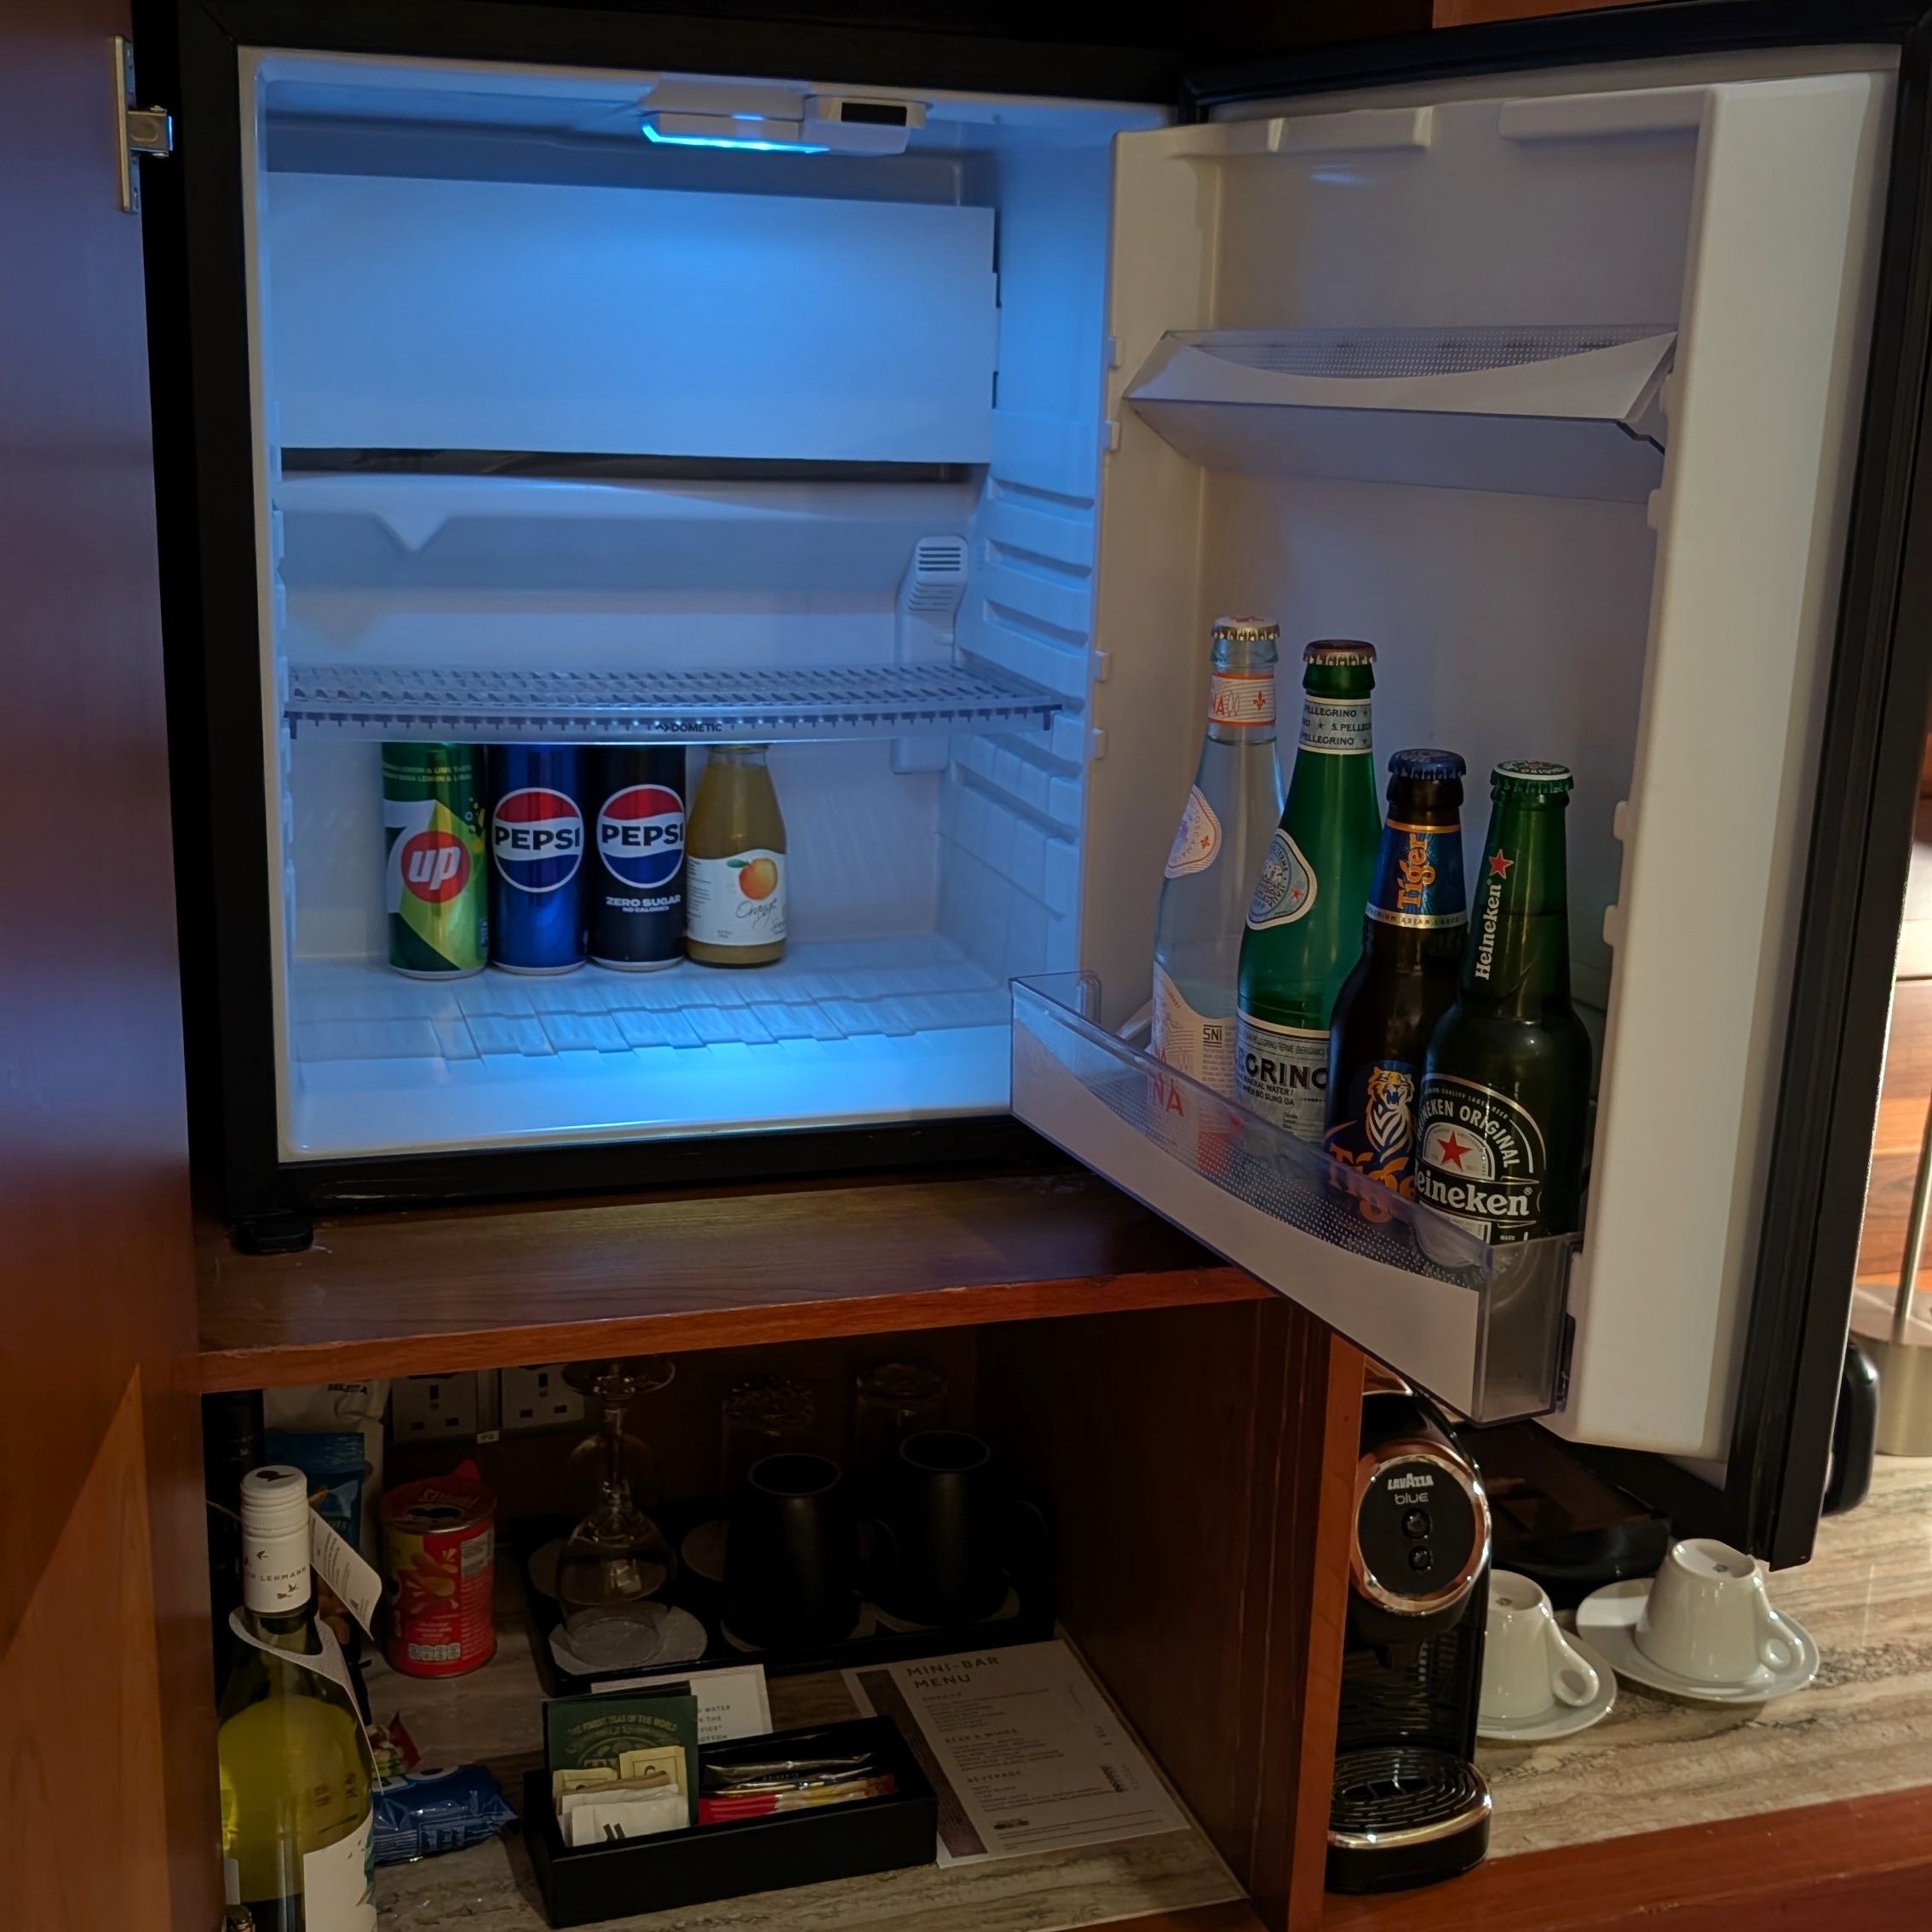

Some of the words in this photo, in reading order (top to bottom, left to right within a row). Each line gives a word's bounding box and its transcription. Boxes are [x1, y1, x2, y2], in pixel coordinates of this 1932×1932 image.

[671, 723, 722, 733] DOMETIC
[494, 826, 580, 850] PEPSI
[601, 823, 683, 847] PEPSI
[1397, 833, 1436, 909] Tiger
[606, 896, 641, 907] ZERO
[642, 894, 681, 907] SUGAR
[1401, 917, 1430, 925] ASIAN
[1475, 883, 1502, 980] Heineken
[1203, 1027, 1222, 1042] SNI
[1267, 1084, 1289, 1095] WATER
[1459, 1105, 1521, 1168] ORIGINAL
[1328, 1142, 1416, 1222] Tige
[1415, 1167, 1530, 1216] eineken
[1388, 1473, 1434, 1490] LAVAZZA
[1394, 1492, 1429, 1505] blue
[906, 1657, 999, 1676] MINI-BAR
[914, 1674, 971, 1688] MENU
